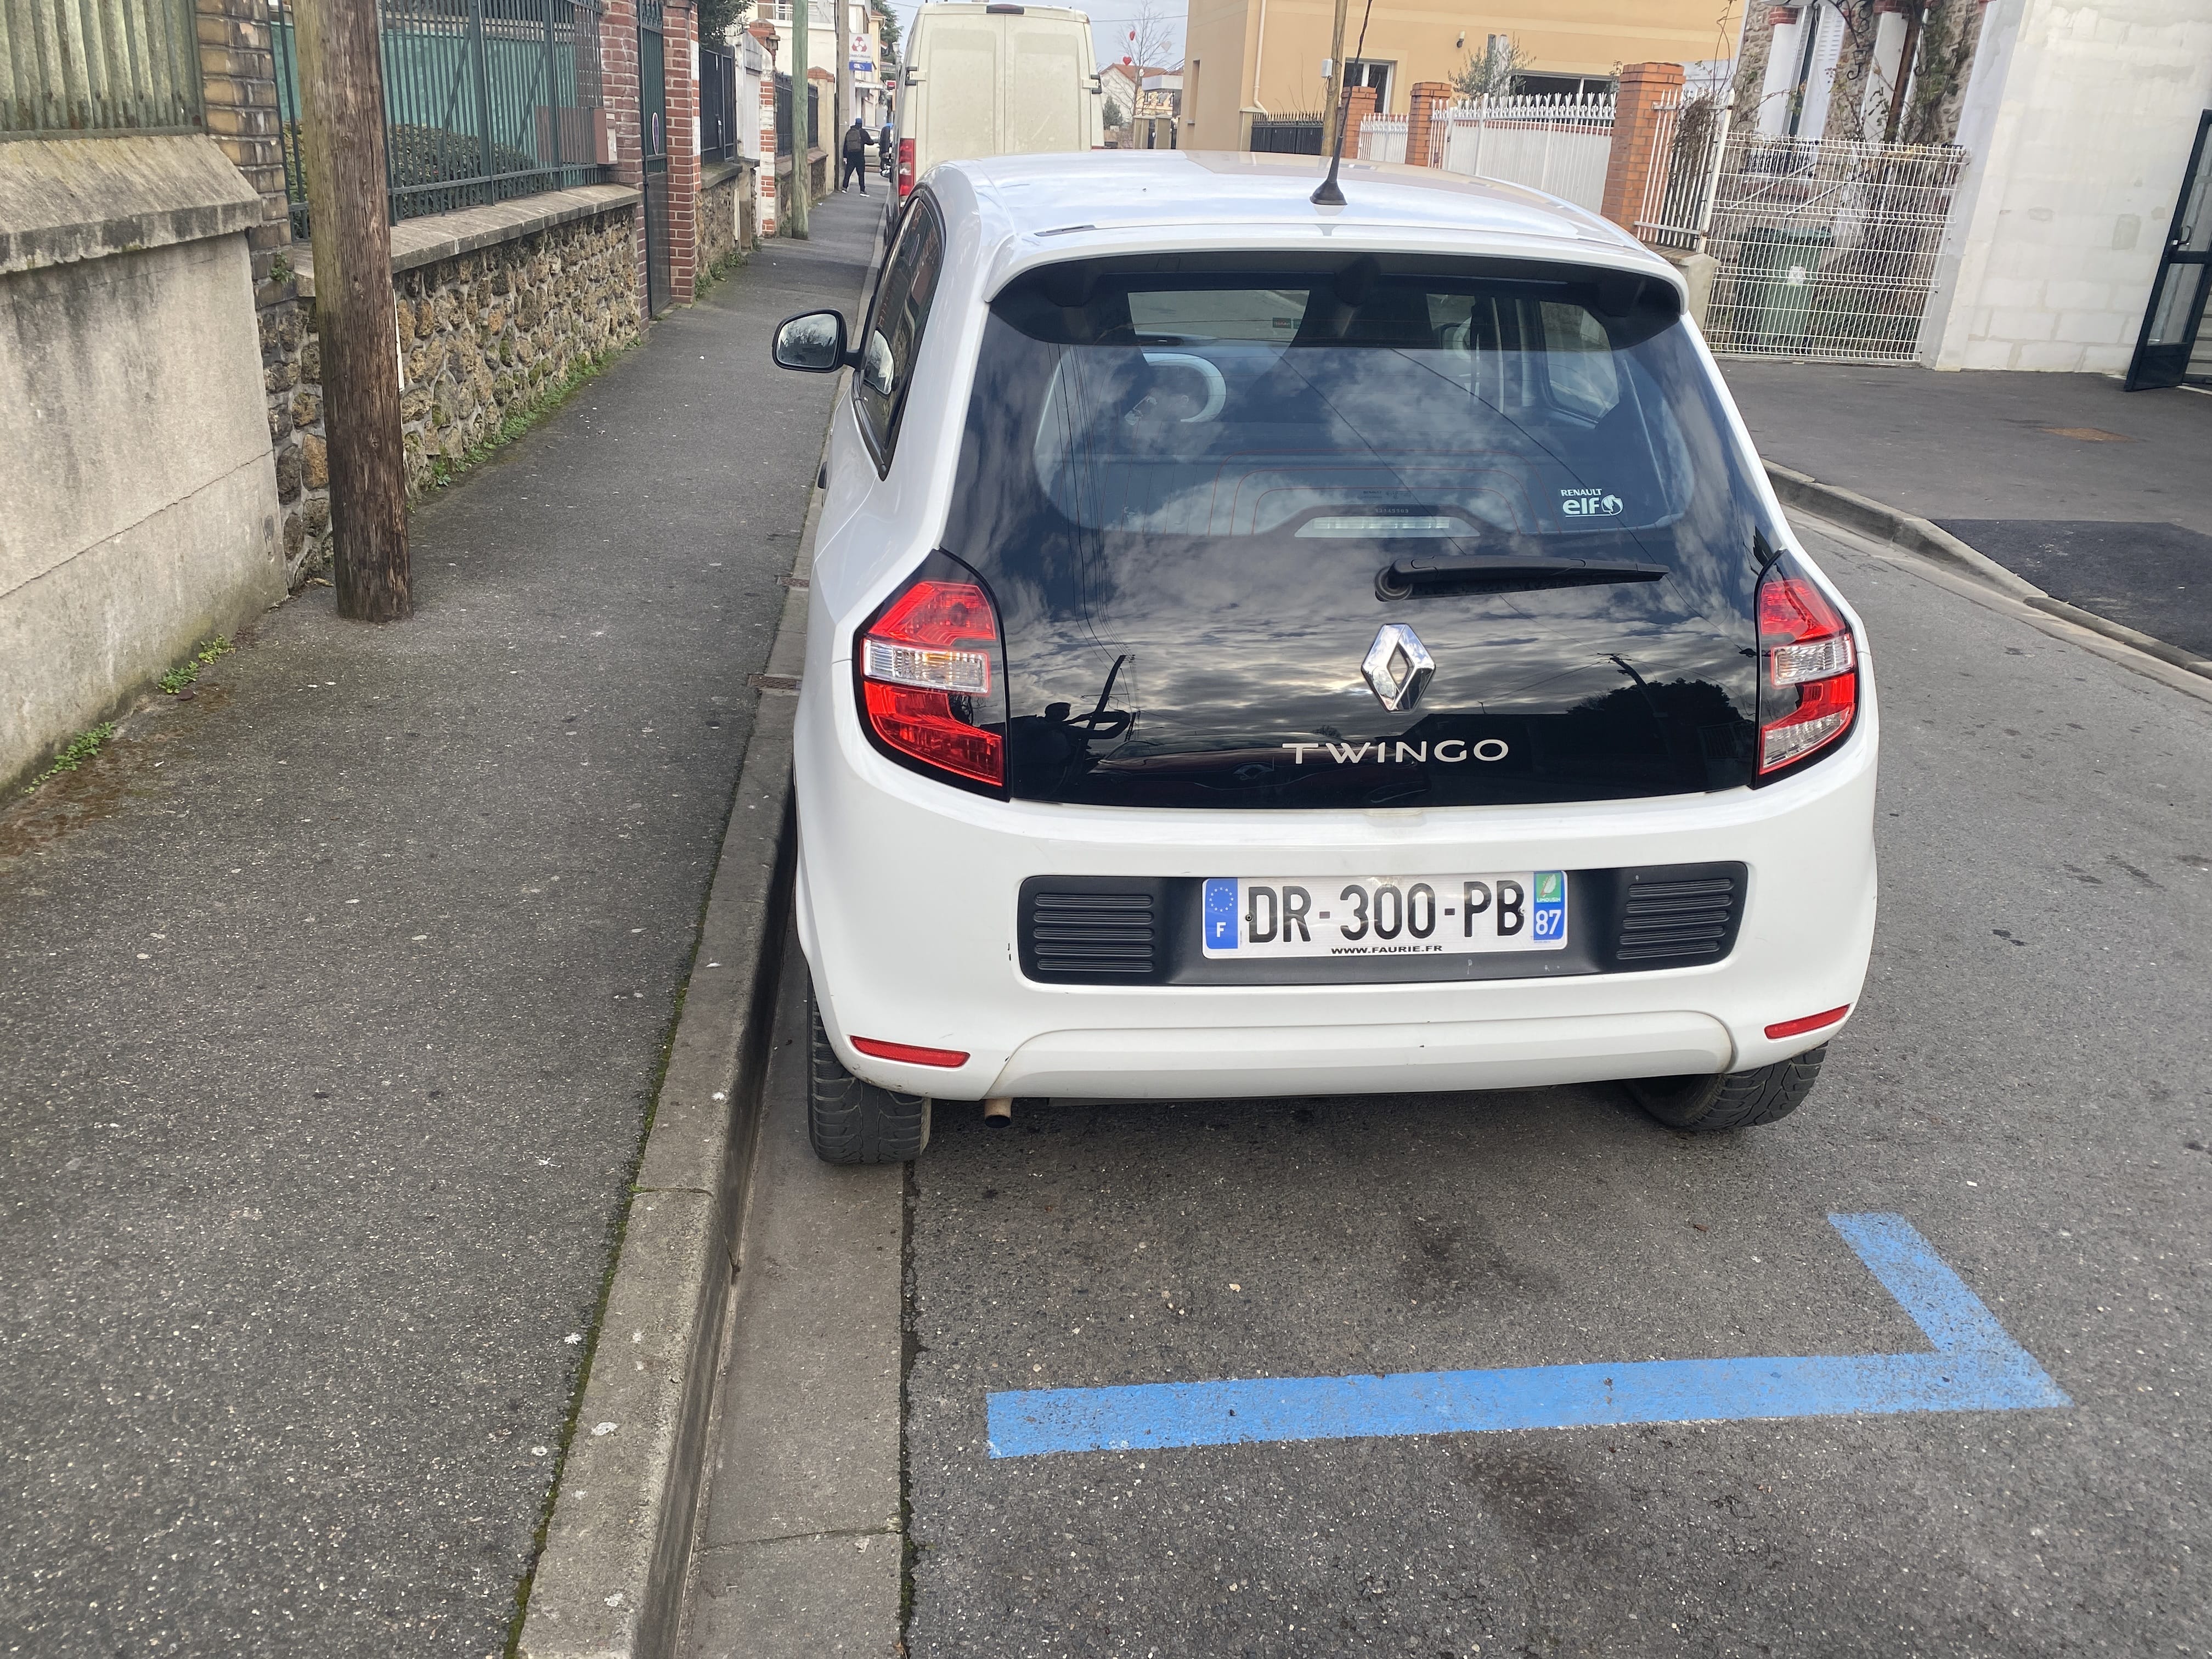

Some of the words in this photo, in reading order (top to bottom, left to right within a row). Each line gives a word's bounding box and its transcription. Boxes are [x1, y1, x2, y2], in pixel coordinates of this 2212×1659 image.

[1562, 498, 1599, 514] elf
[1282, 739, 1509, 764] TWINGO
[1248, 880, 1525, 943] DR-300-PB
[1216, 922, 1227, 938] F
[1536, 910, 1561, 935] 87
[1331, 945, 1443, 954] WWW.FAURIE.FR
